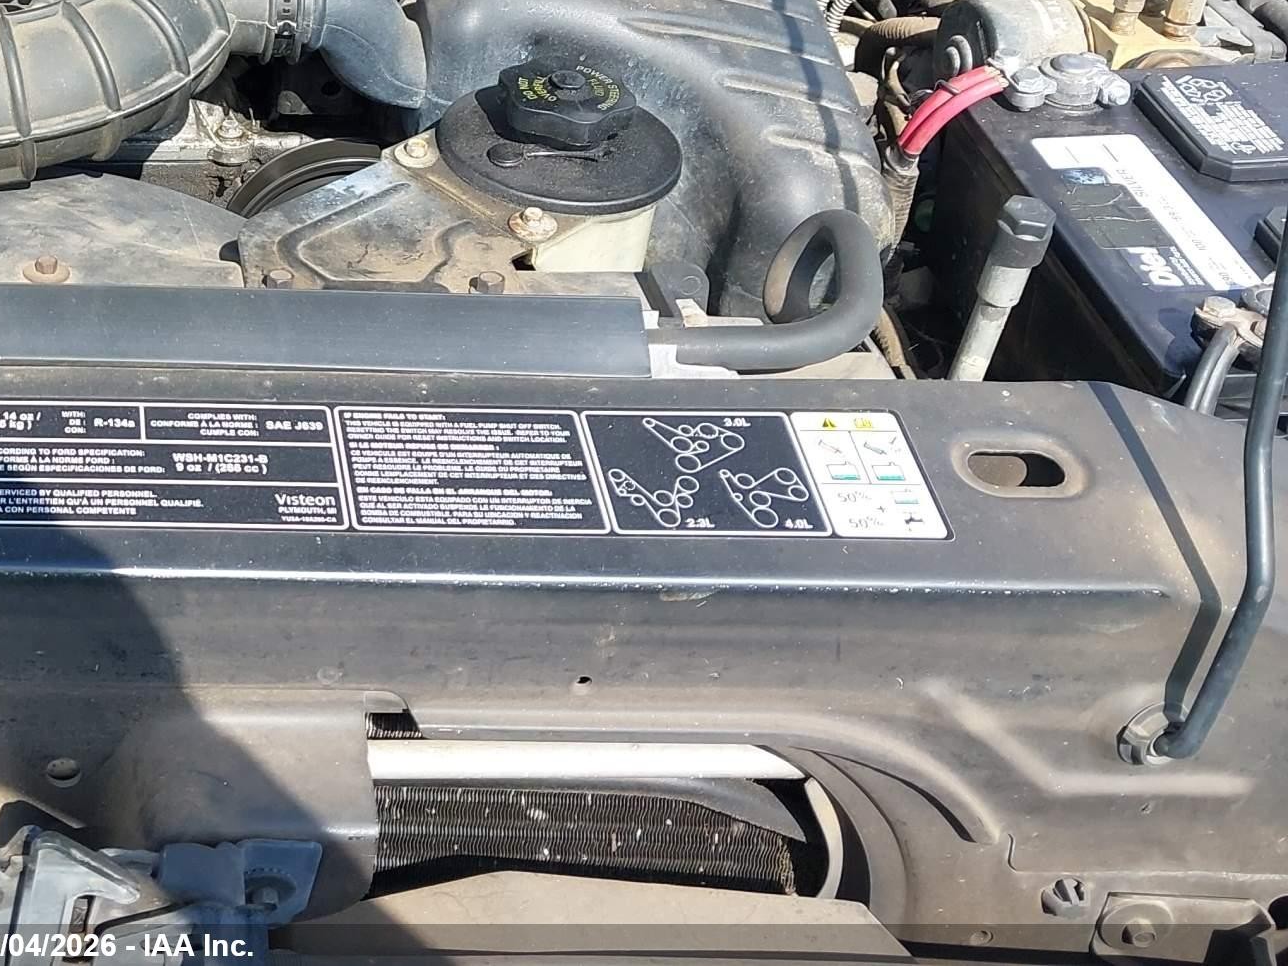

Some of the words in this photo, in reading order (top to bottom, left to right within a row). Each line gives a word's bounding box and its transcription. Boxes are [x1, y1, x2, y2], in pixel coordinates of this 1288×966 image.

[518, 77, 530, 91] NOT
[576, 65, 614, 85] POWER
[597, 84, 620, 111] STEERING
[588, 78, 605, 97] FLUID
[523, 90, 538, 100] DO
[2, 412, 16, 422] 14
[93, 419, 135, 428] R-134a
[265, 421, 291, 430] SAE
[294, 421, 323, 430] J639
[723, 418, 751, 428] 3.0L
[175, 463, 184, 471] 9
[274, 494, 335, 505] Visteon
[685, 518, 715, 529] 2.3L
[784, 519, 813, 530] 4.0L
